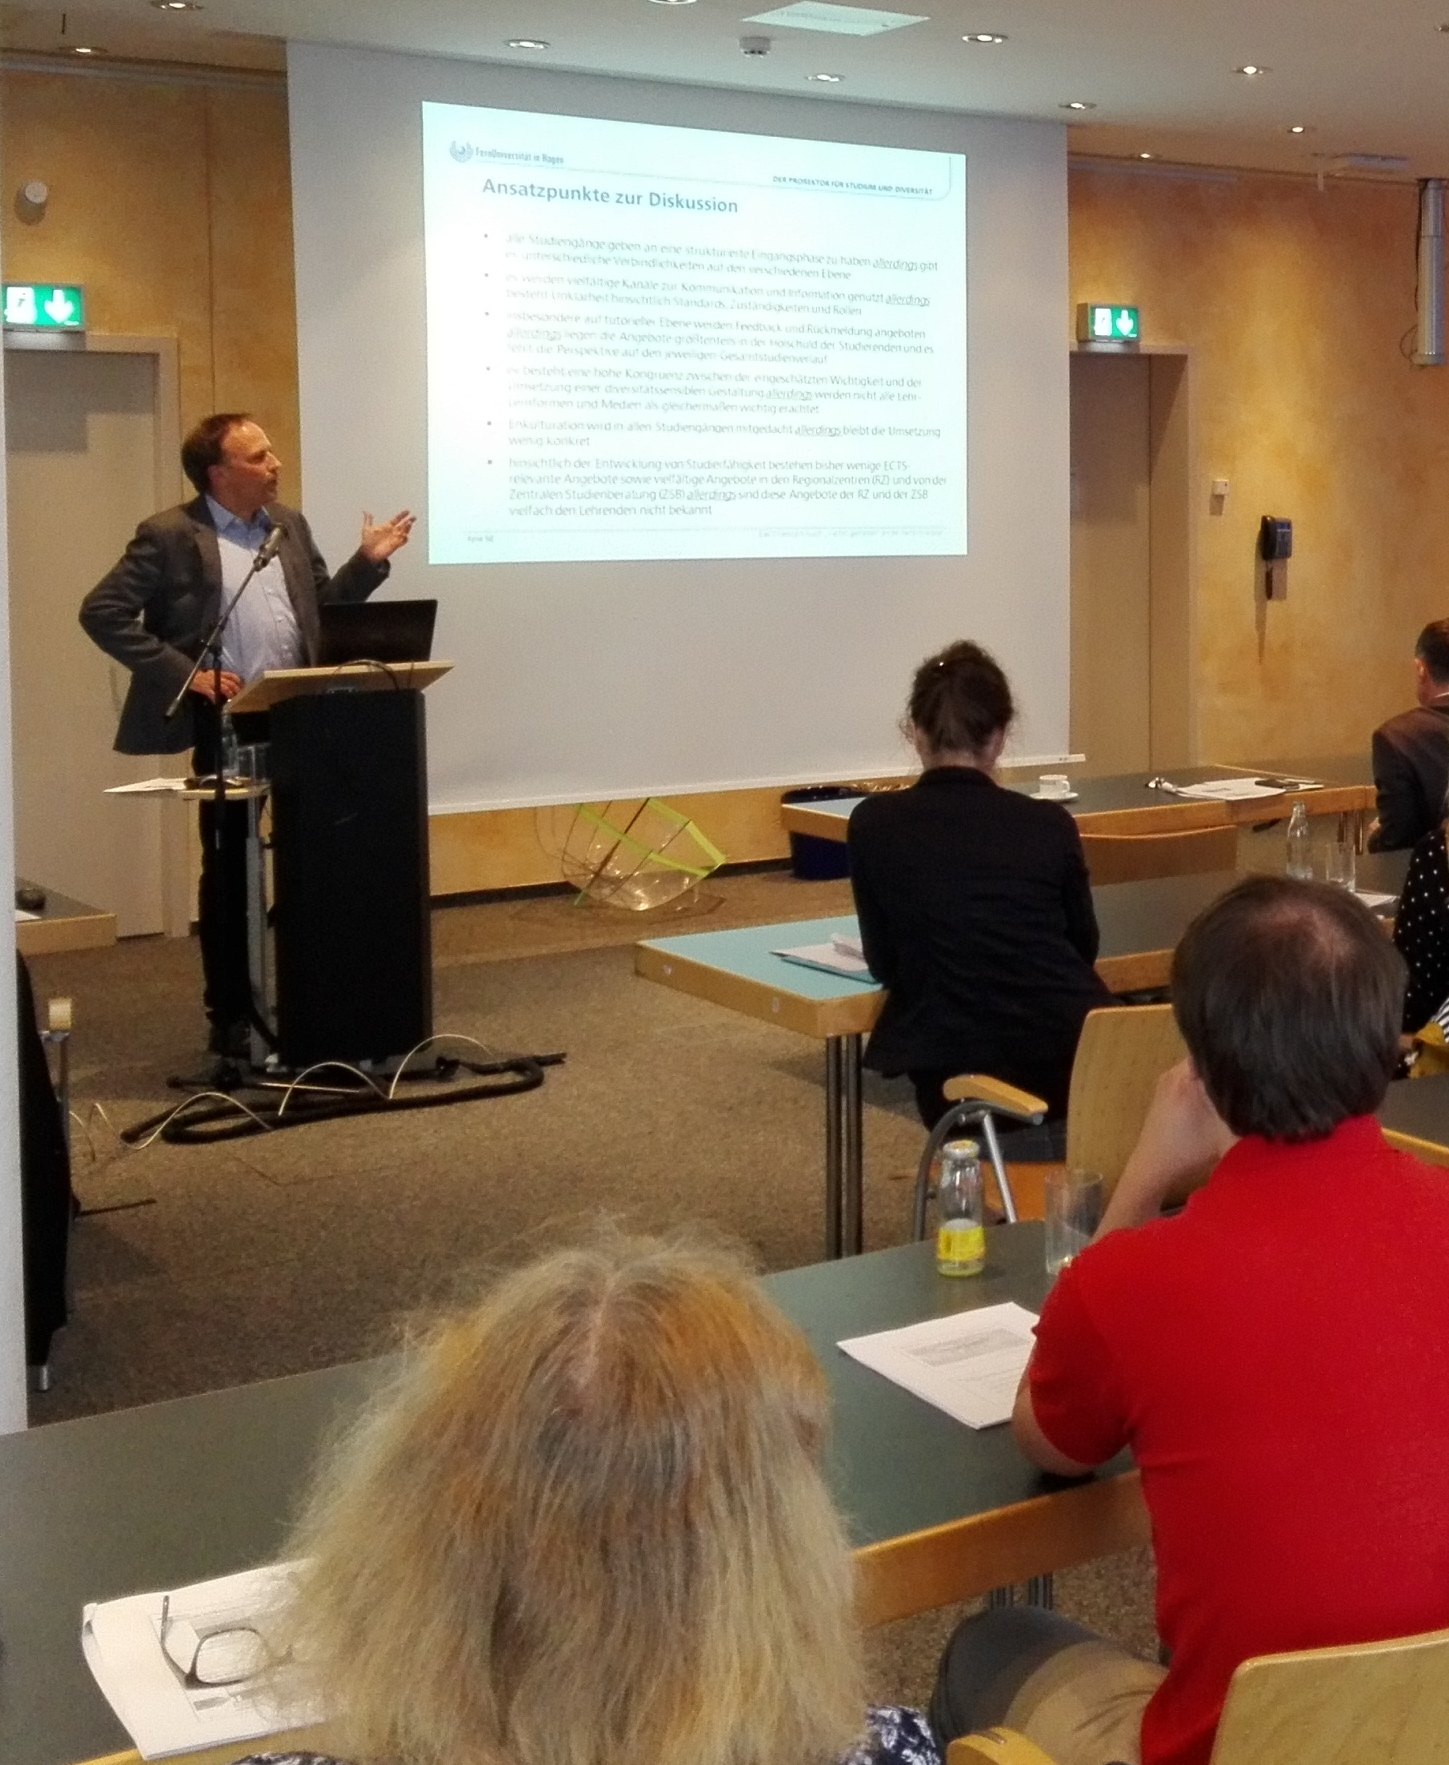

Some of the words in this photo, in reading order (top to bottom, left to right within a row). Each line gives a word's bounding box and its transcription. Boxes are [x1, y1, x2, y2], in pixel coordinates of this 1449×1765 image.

[482, 177, 611, 207] Ansatzpunkte
[615, 192, 643, 206] zur
[649, 191, 738, 213] Diskussion
[895, 184, 933, 196] DIVERSITÄT
[586, 420, 612, 430] wird
[626, 421, 652, 431] allen
[655, 421, 734, 436] Studiengängen
[794, 424, 842, 438] allerdings
[842, 425, 870, 435] bleibt
[871, 426, 886, 436] die
[888, 426, 942, 439] Umsetzung
[508, 434, 544, 448] wenig
[546, 435, 590, 446] konkret
[573, 458, 591, 468] der
[595, 458, 663, 471] Entwicklung
[686, 459, 766, 472] Studierfähigkeit
[768, 460, 813, 470] bestehen
[815, 460, 844, 470] bisher
[846, 461, 881, 473] wenige
[883, 461, 909, 470] ECTS-
[508, 473, 562, 483] relevante
[564, 473, 618, 487] Angebote
[620, 474, 652, 484] sowie
[654, 474, 705, 487] vielfältige
[706, 474, 757, 487] Angebote
[759, 475, 768, 484] in
[771, 475, 790, 484] den
[792, 475, 870, 488] Regionalzentren
[871, 476, 890, 488] (RZ)
[892, 476, 912, 485] und
[932, 476, 947, 485] der
[509, 489, 564, 499] Zentralen
[565, 489, 657, 502] Studienberatung
[658, 490, 686, 502] (ZSB)
[686, 490, 737, 502] allerdings
[738, 490, 760, 499] sind
[760, 490, 786, 500] diese
[789, 490, 838, 502] Angebote
[839, 490, 854, 500] der
[857, 490, 870, 500] RZ
[872, 490, 892, 500] und
[893, 490, 908, 500] der
[910, 490, 929, 500] ZSB
[508, 505, 554, 516] vielfach
[554, 505, 576, 515] den
[579, 505, 637, 515] Lehrenden
[639, 505, 666, 515] nicht
[668, 505, 713, 515] bekannt
